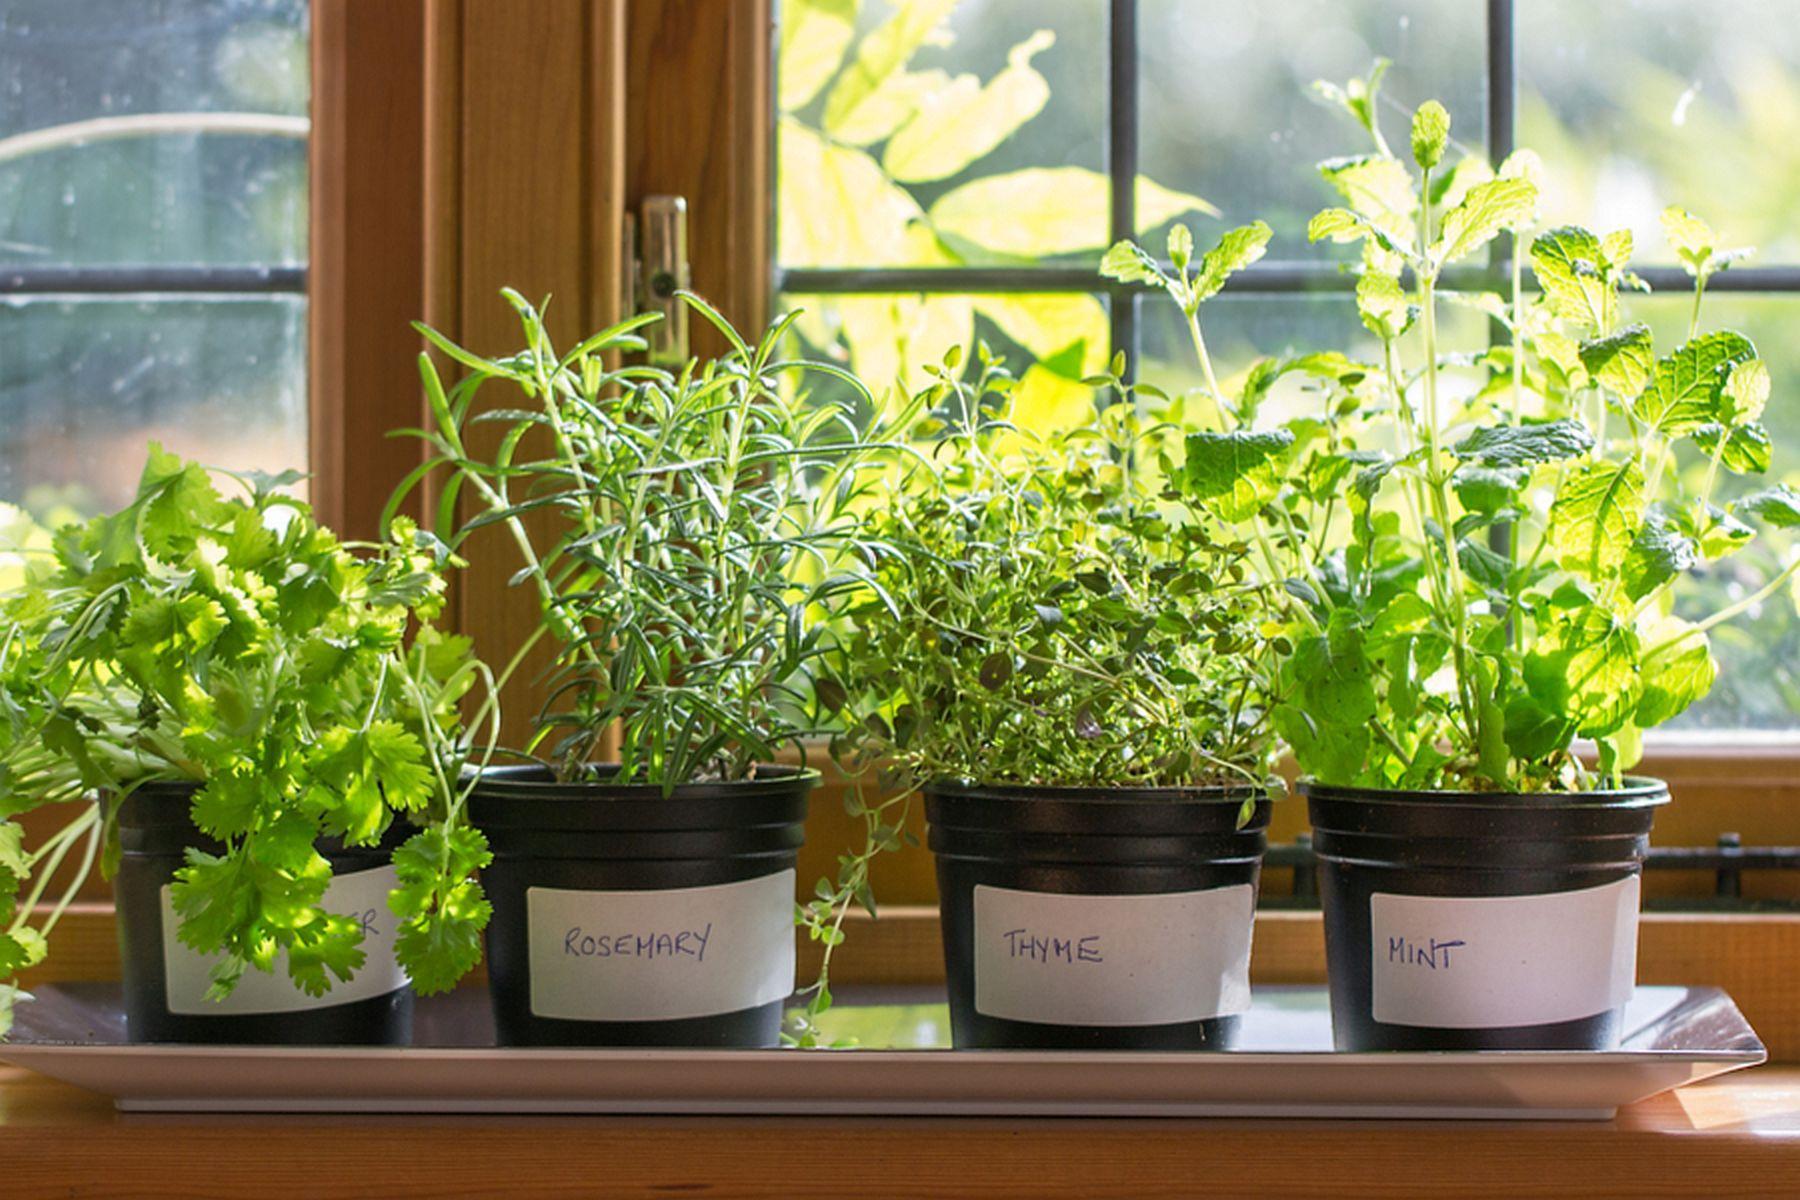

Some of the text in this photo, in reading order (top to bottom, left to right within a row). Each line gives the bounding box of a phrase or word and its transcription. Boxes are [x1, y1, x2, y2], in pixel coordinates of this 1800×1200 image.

[564, 923, 712, 961] ROSEMARY
[1003, 929, 1103, 963] THYME
[1389, 937, 1466, 969] MINT
